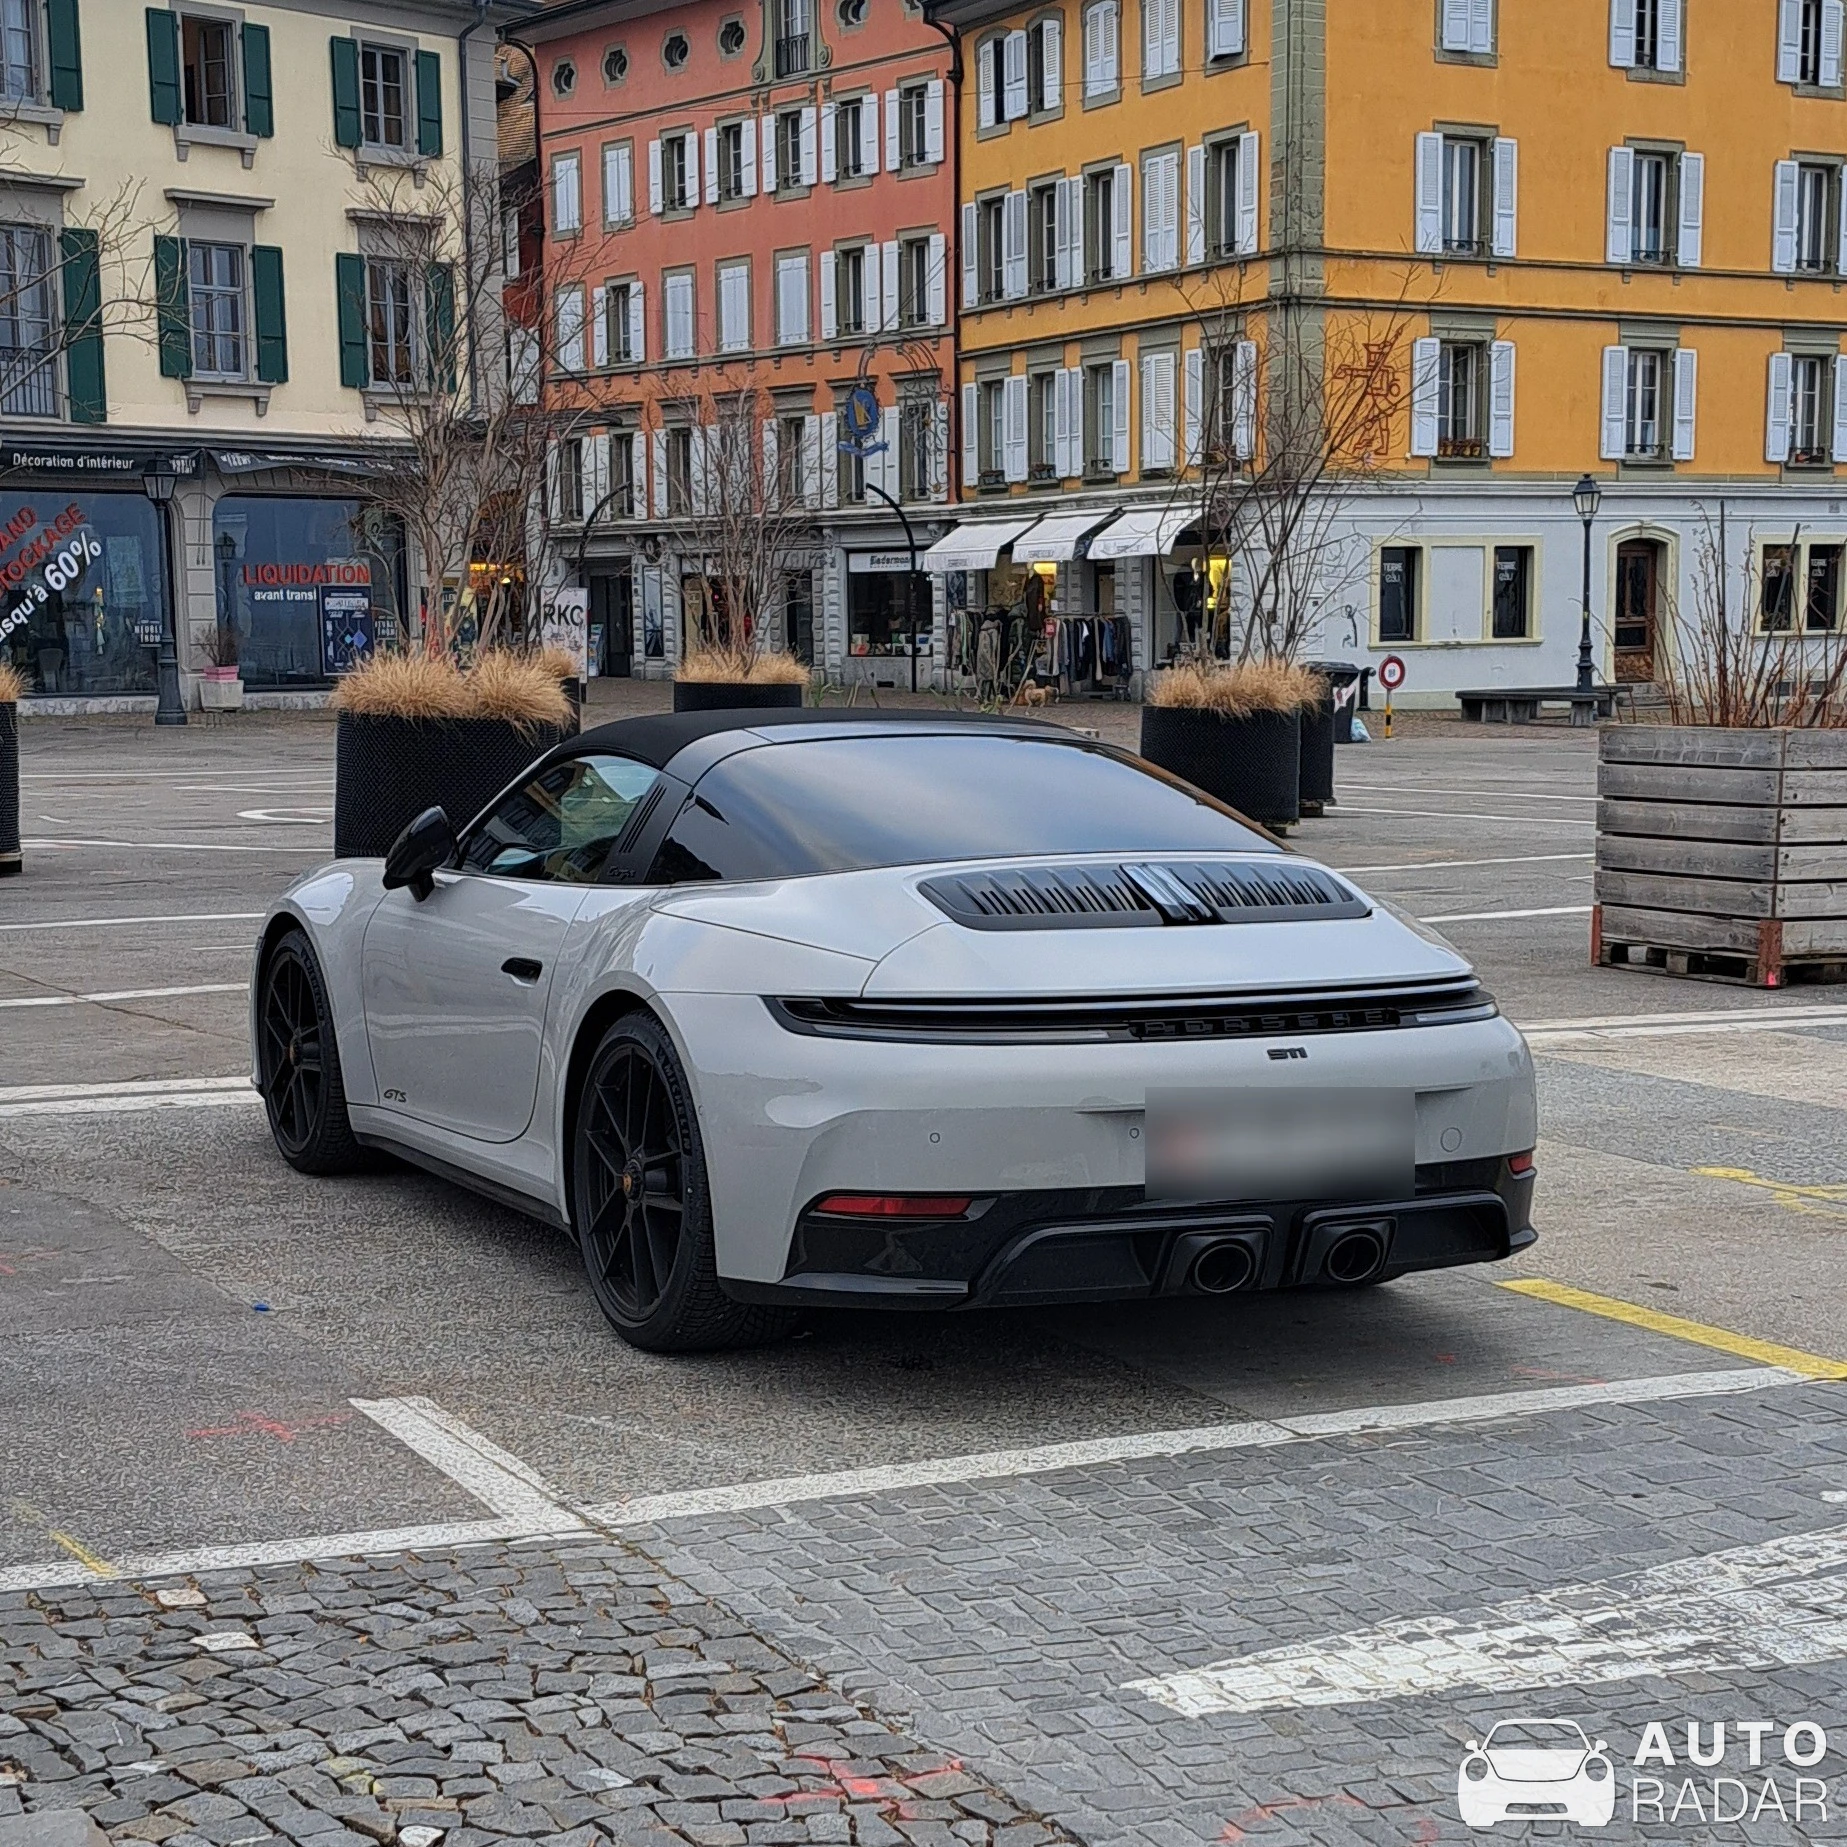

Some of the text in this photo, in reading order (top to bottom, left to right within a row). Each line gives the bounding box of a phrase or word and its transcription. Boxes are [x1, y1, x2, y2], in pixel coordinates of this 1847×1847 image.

[12, 452, 136, 470] Décoration d'intérieur
[44, 531, 102, 591] 60%
[243, 563, 371, 586] LIQUIDATION
[254, 588, 285, 601] avant
[1144, 1008, 1386, 1036] PORSCHE
[383, 1088, 407, 1103] GTS
